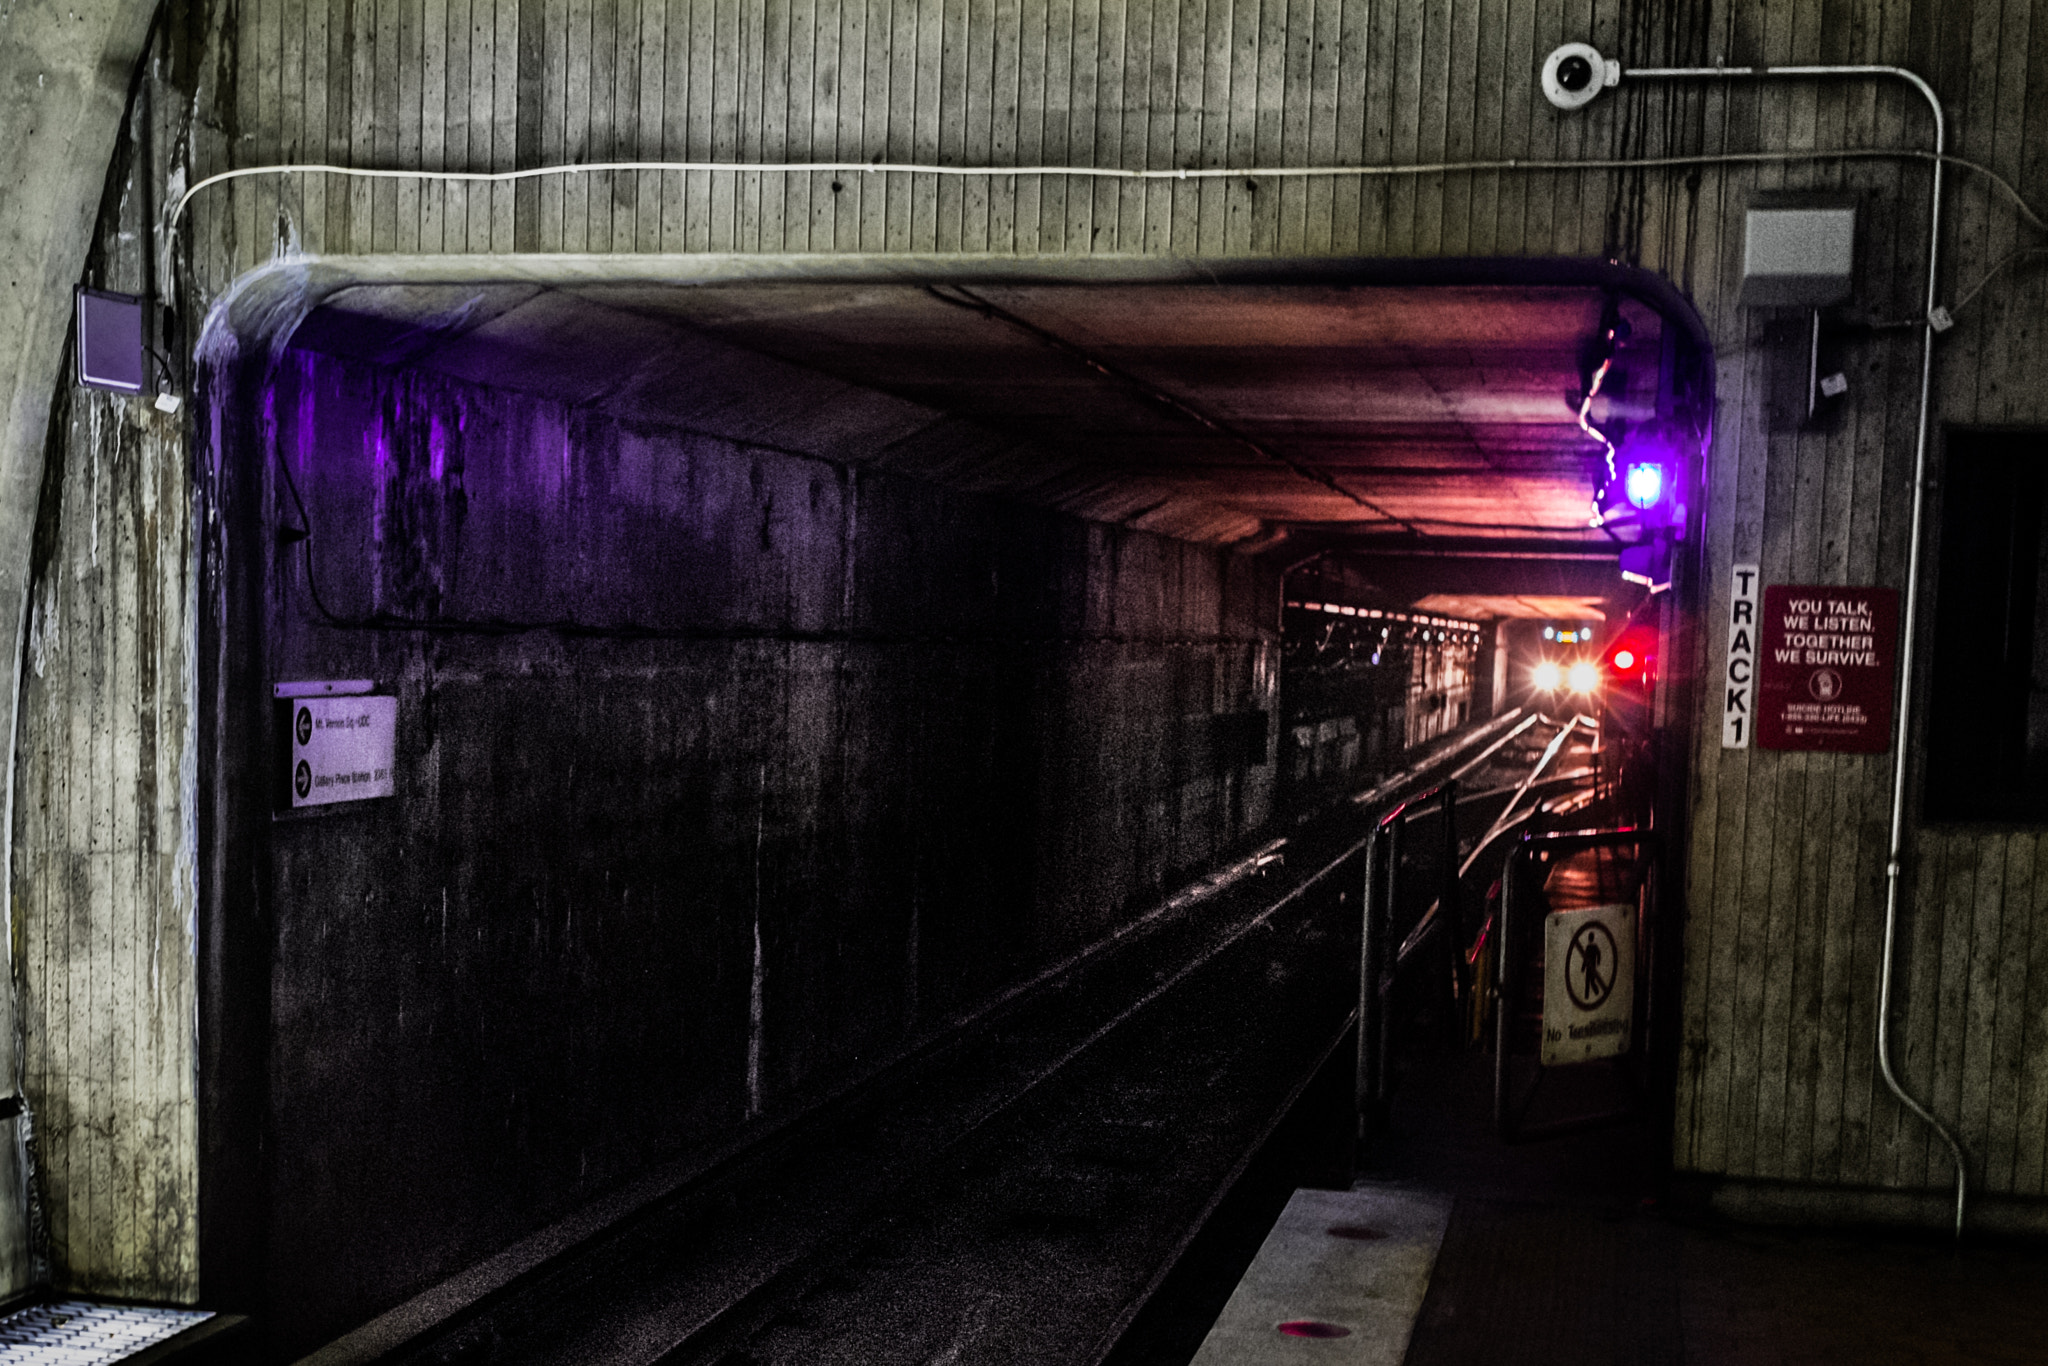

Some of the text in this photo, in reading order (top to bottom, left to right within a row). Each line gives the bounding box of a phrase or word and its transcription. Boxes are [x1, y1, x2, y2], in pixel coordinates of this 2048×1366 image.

[1788, 599, 1872, 617] YOU TALK,
[1783, 615, 1809, 630] WE
[1784, 632, 1873, 649] TOGETHER
[1727, 571, 1755, 743] TRACK 1
[1775, 649, 1800, 664] WE
[1547, 1028, 1561, 1042] No
